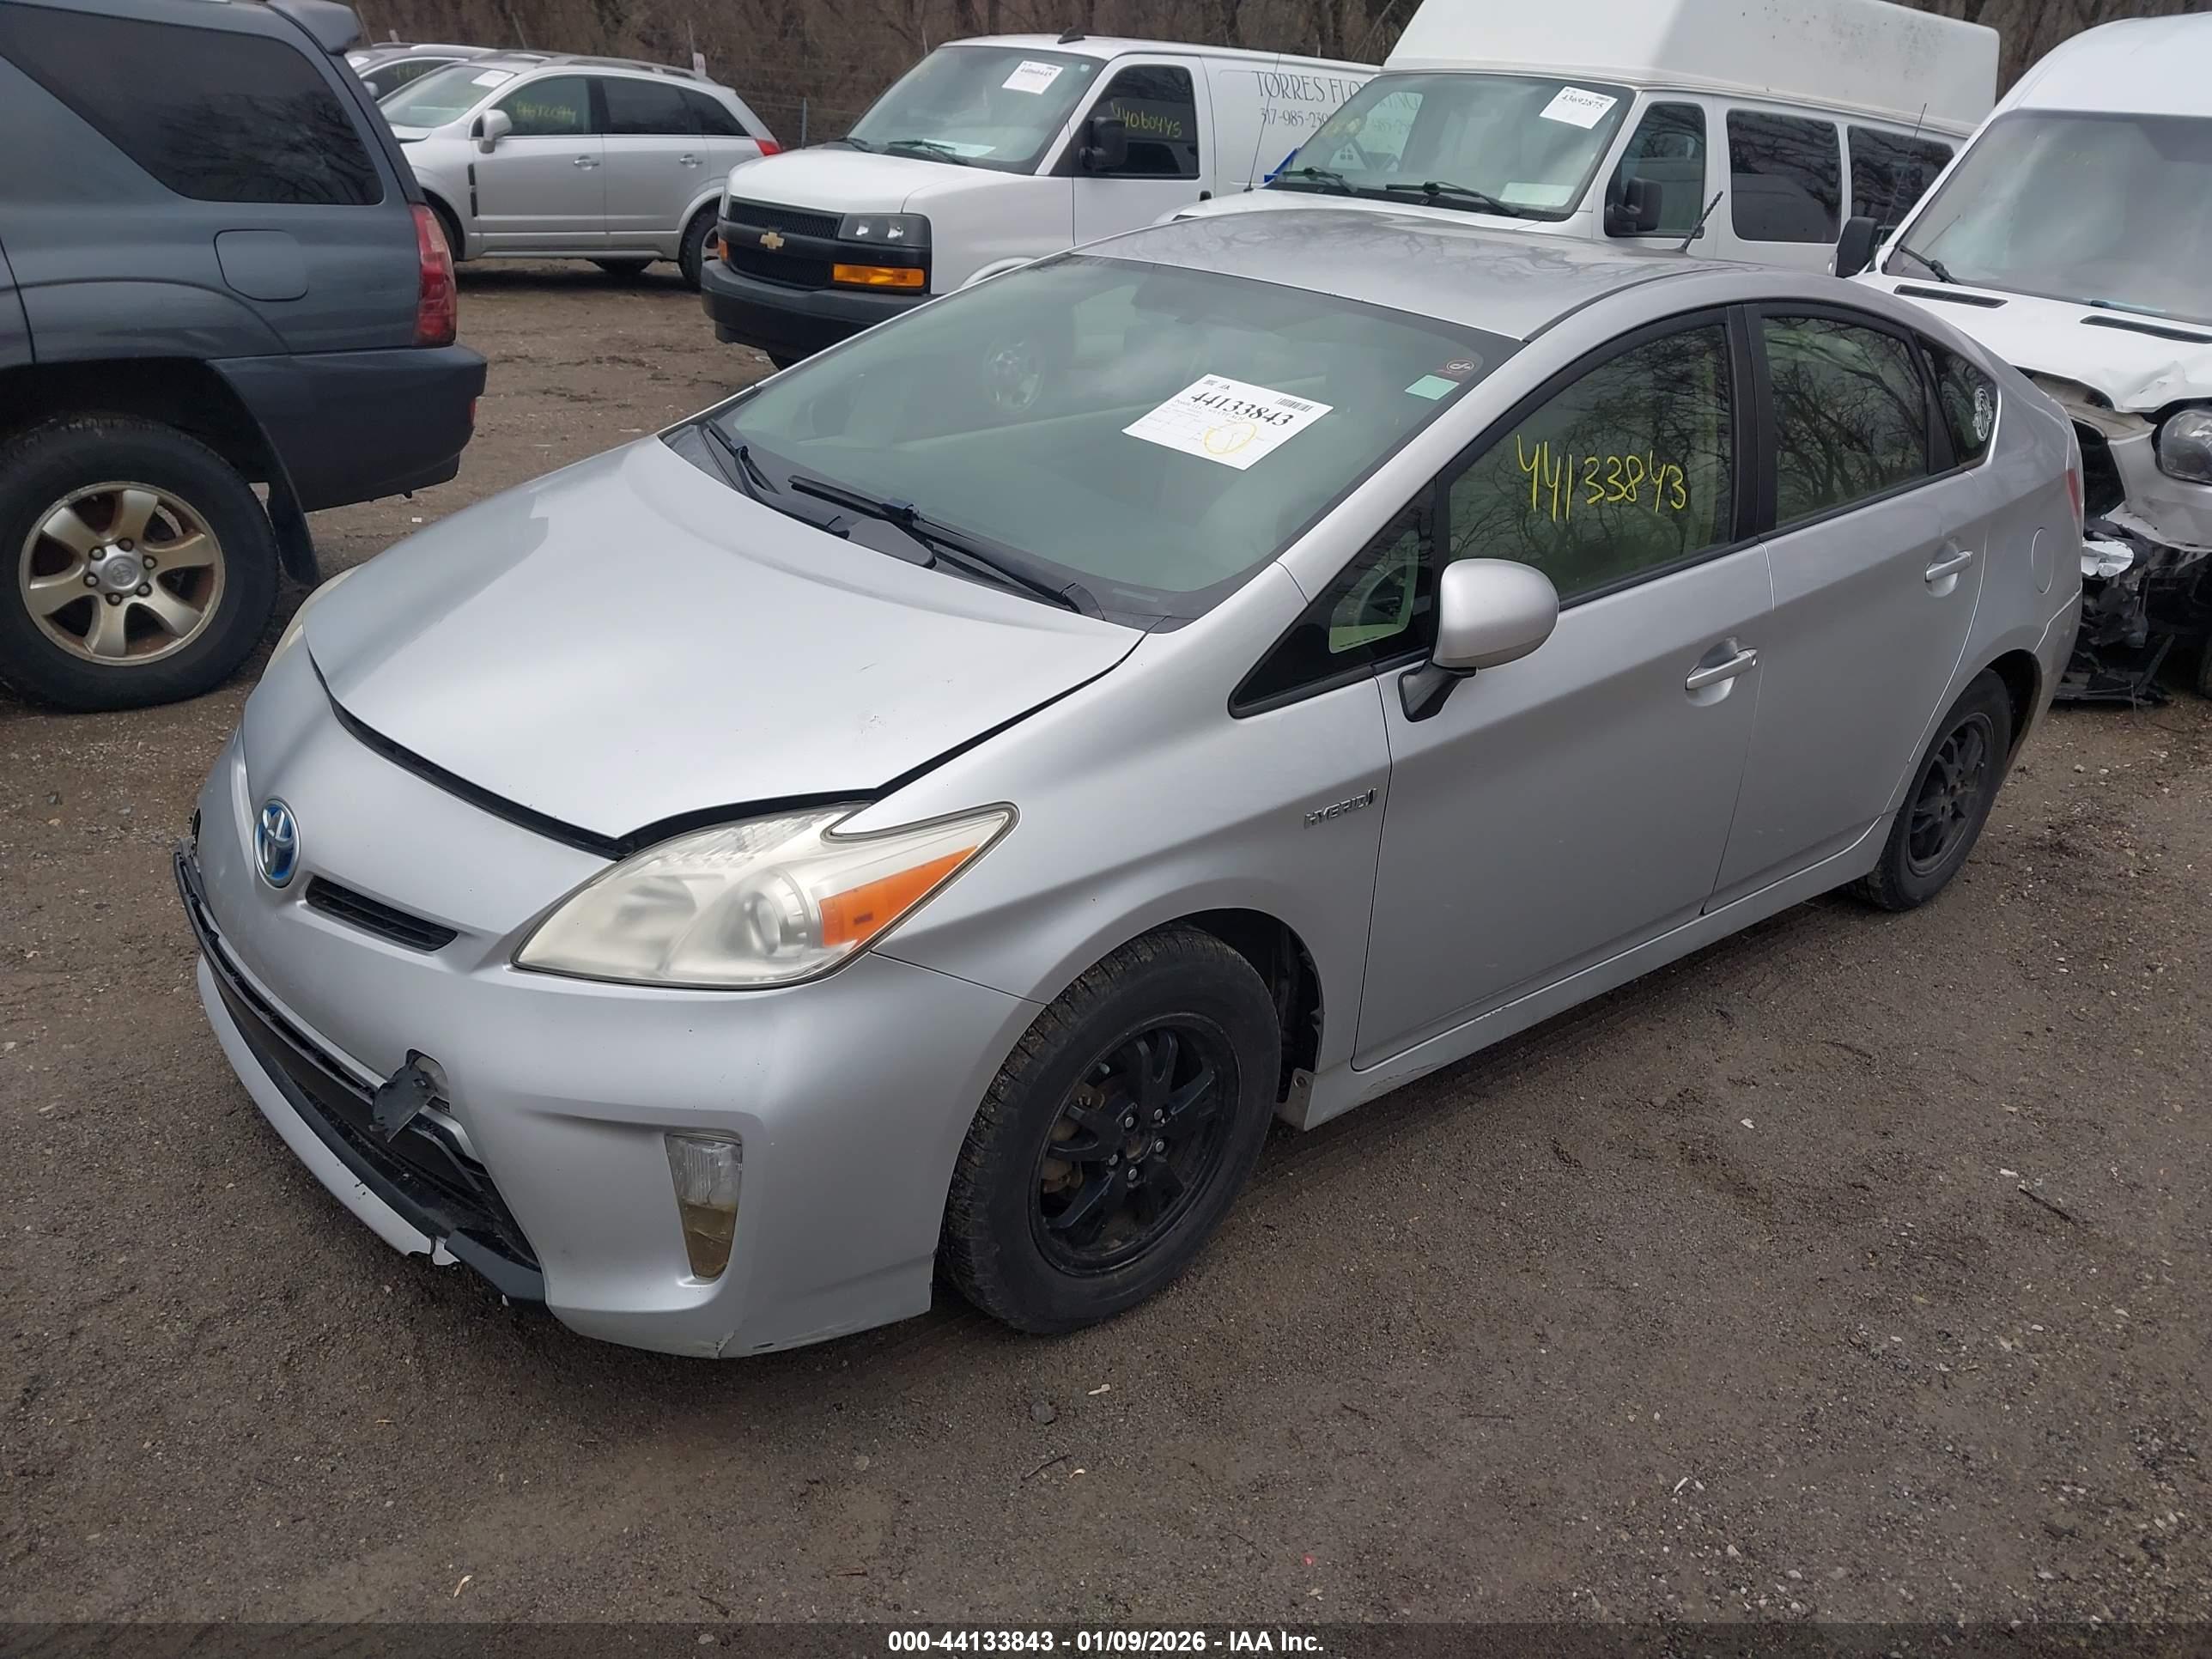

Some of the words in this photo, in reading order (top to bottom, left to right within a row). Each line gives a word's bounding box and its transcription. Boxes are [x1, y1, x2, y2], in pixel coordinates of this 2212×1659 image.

[1252, 70, 1325, 102] TORRES
[1329, 78, 1362, 104] FLO
[1190, 392, 1295, 427] 44133843
[1516, 434, 1687, 523] 44133843
